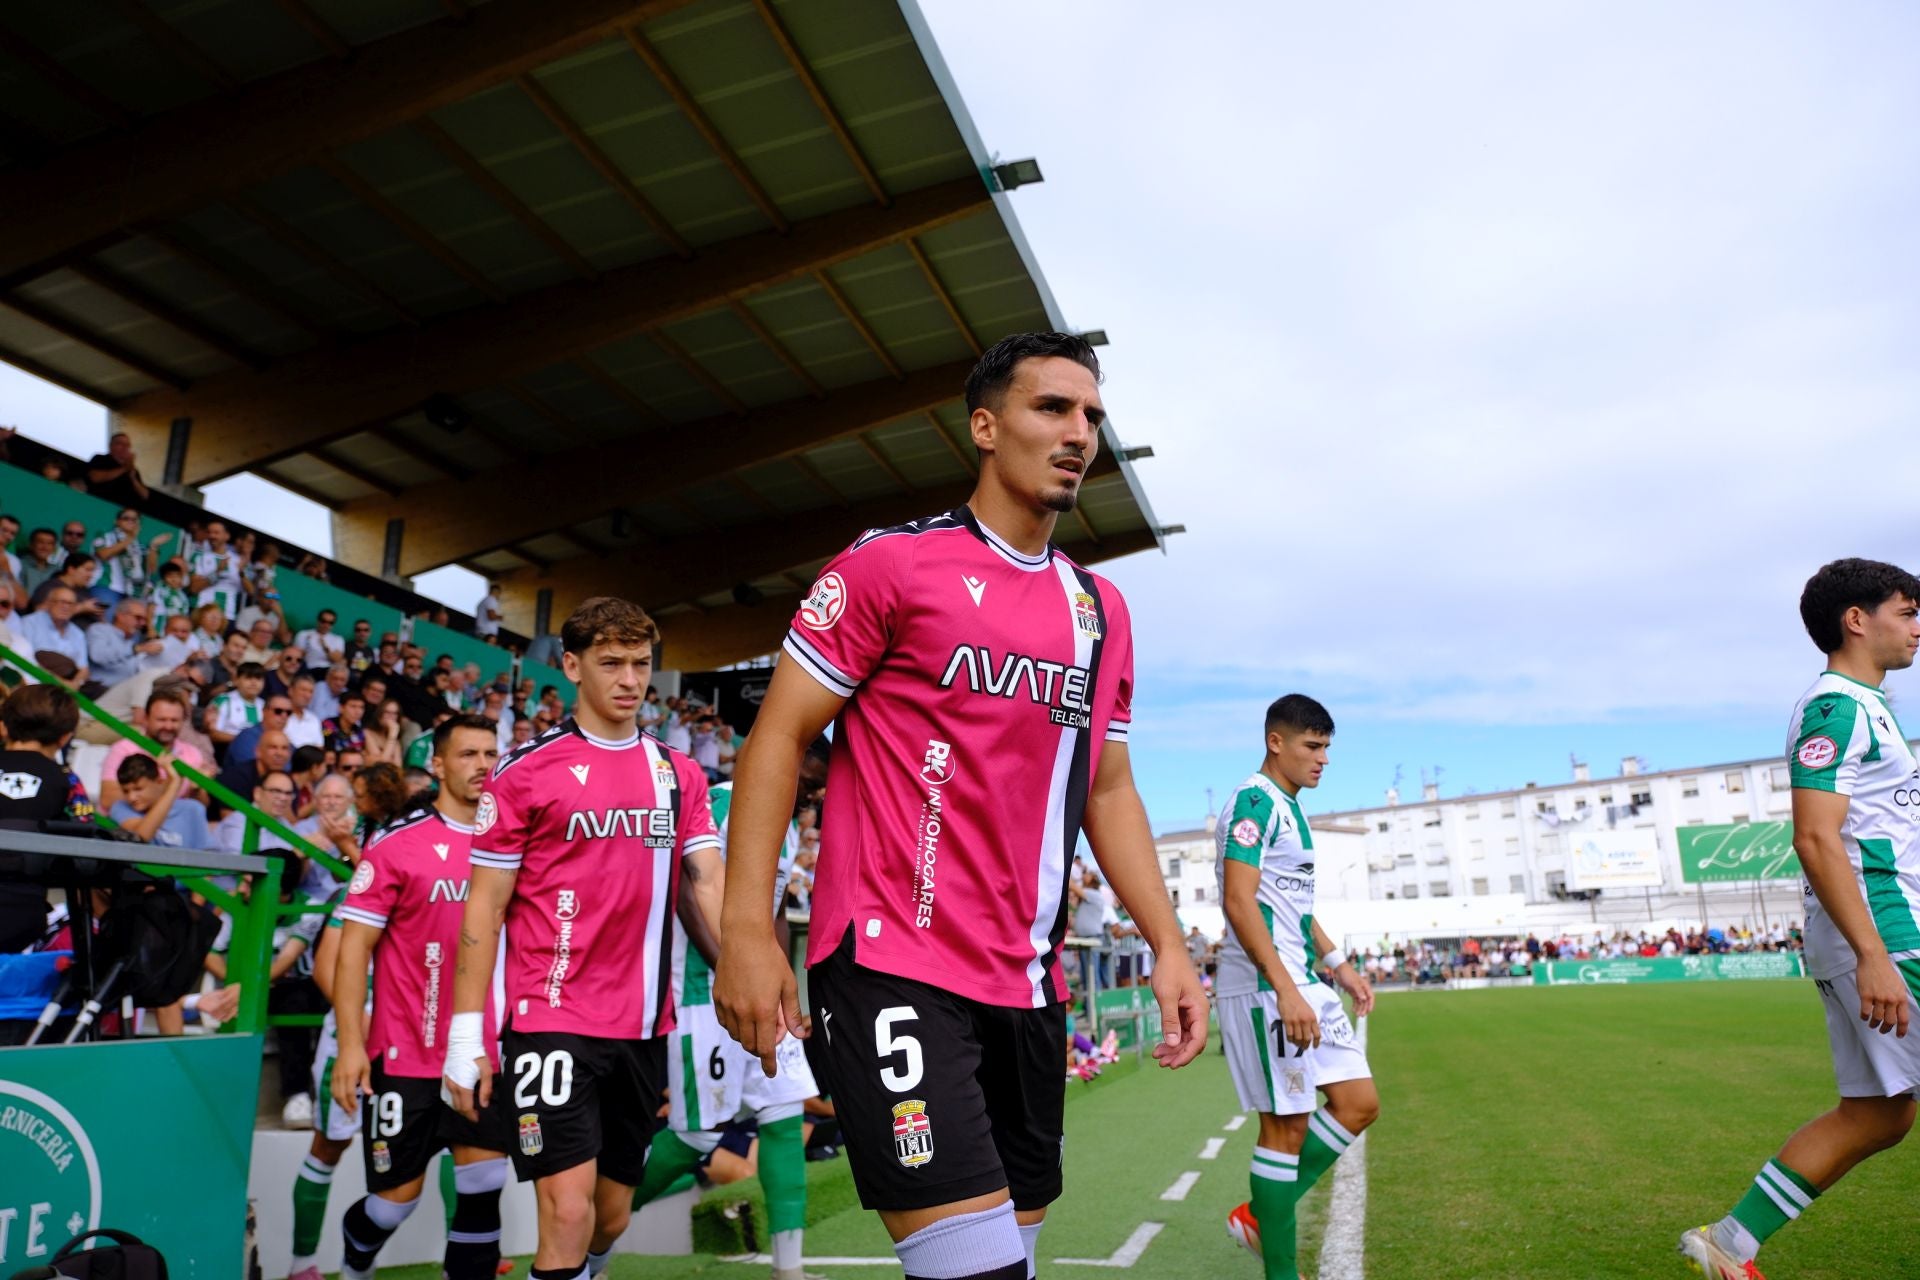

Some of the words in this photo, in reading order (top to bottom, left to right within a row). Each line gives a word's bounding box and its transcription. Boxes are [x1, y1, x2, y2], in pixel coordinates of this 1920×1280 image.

[940, 645, 1091, 713] AVATEL
[1050, 708, 1090, 728] TELECOM
[564, 808, 677, 841] AVATEL
[643, 837, 677, 849] TELECO
[915, 786, 942, 929] INMOHOGARES
[428, 878, 470, 903] AV
[709, 1045, 725, 1080] 6
[875, 1006, 924, 1093] 5
[514, 1050, 573, 1109] 20
[368, 1091, 403, 1140] 19
[0, 1106, 74, 1175] RNICERÍA
